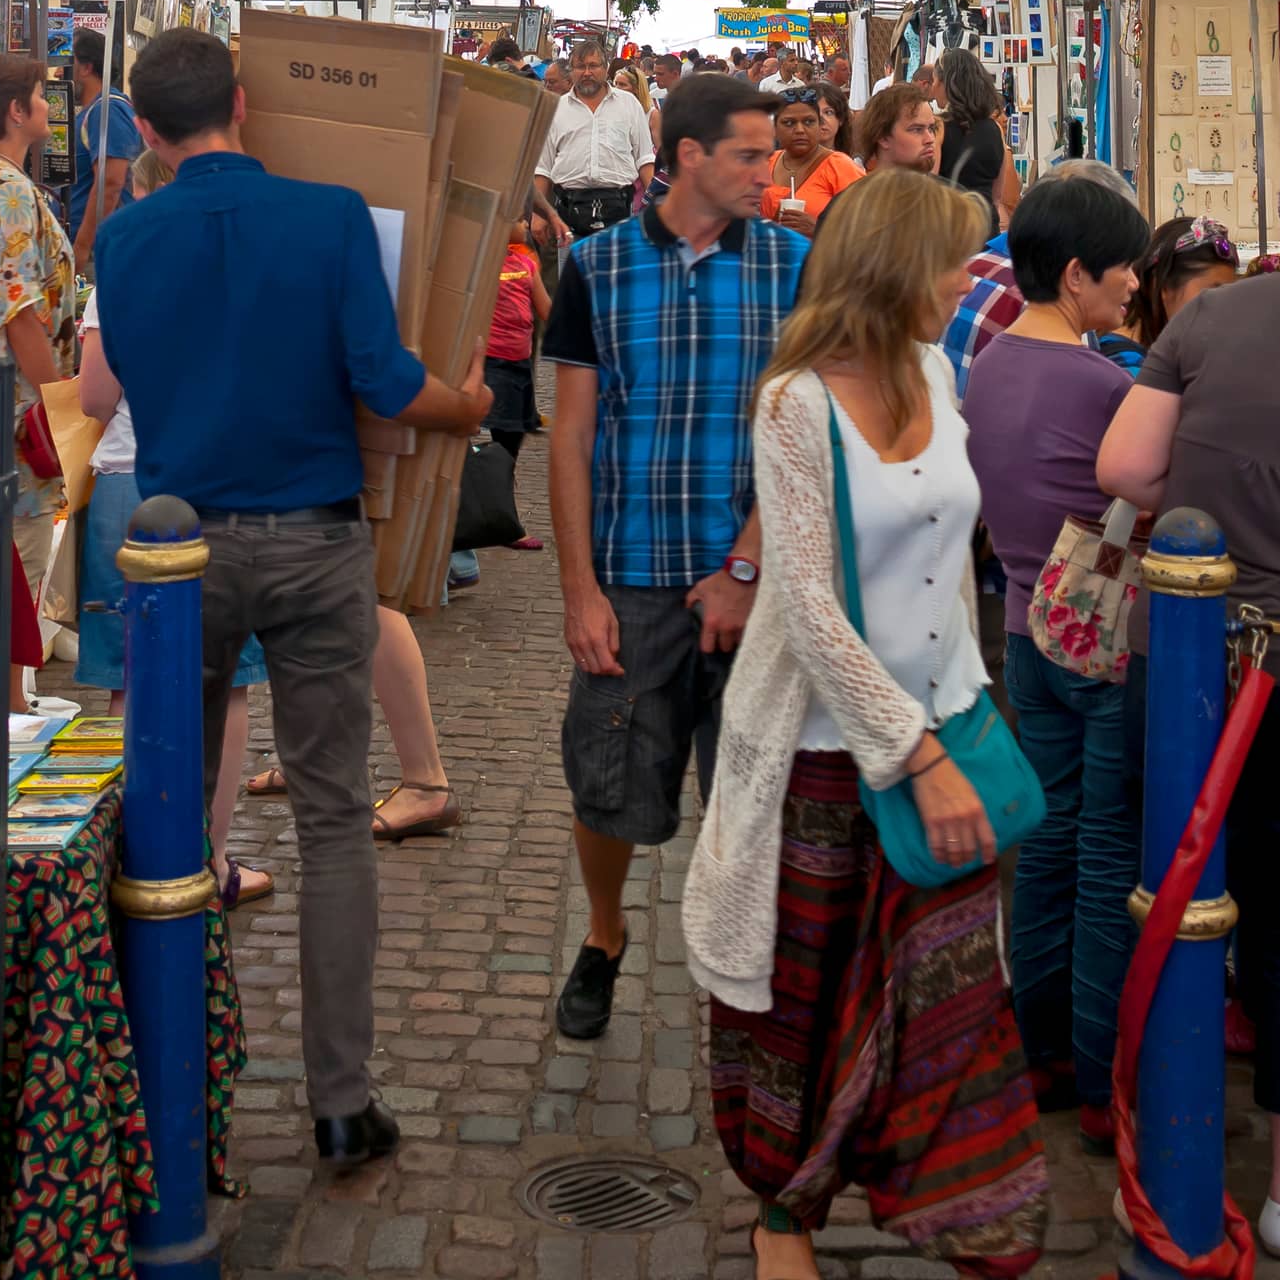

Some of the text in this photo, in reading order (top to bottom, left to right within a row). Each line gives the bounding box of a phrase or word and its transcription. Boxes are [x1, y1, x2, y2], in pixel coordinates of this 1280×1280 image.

[722, 11, 761, 22] TROPICAL
[721, 21, 807, 36] Fresh Juice Bar
[289, 61, 378, 89] SD 356 01
